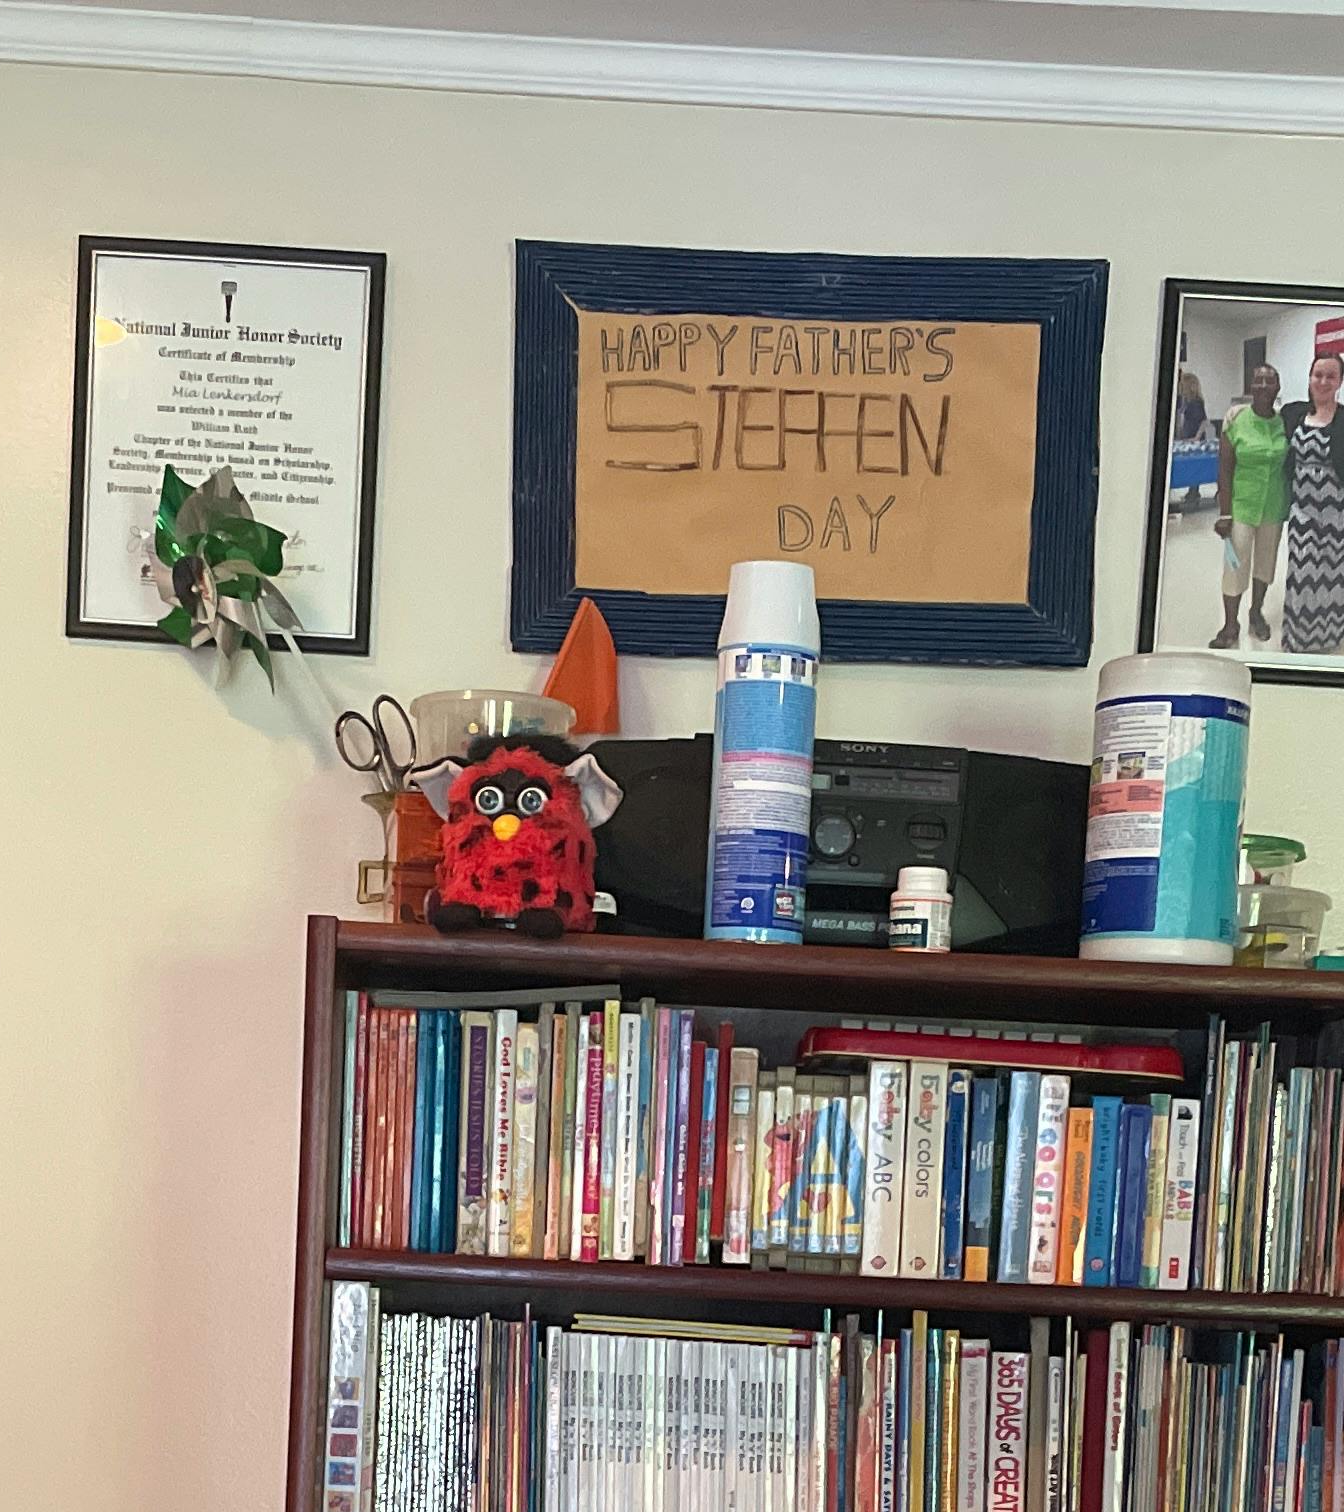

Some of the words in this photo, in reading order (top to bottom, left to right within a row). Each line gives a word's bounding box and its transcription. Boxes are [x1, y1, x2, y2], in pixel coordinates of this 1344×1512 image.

[180, 322, 230, 340] Junior
[237, 326, 285, 343] Honor
[288, 329, 342, 350] Society
[159, 347, 211, 361] Certificate
[216, 352, 226, 361] of
[231, 352, 295, 366] Membership
[601, 323, 738, 376] HAPPY
[751, 327, 955, 382] FATHER'S
[172, 386, 198, 397] Mia
[180, 370, 202, 381] This
[254, 376, 273, 386] that
[192, 421, 229, 432] William
[605, 379, 951, 477] STEFFEN
[155, 450, 212, 463] Membership
[205, 438, 244, 450] National
[248, 442, 279, 452] Junior
[284, 443, 313, 454] Honor
[778, 495, 895, 553] DAY
[840, 744, 889, 753] SONY
[812, 919, 844, 929] MEGA
[847, 920, 875, 931] BASS
[500, 1037, 512, 1067] God
[500, 1072, 511, 1113] Loves
[470, 1098, 483, 1142] JESUS
[499, 1118, 509, 1138] Me
[872, 1153, 892, 1202] ABC
[915, 1139, 935, 1198] colors
[1175, 1180, 1194, 1222] BABY
[996, 1356, 1025, 1389] 365
[996, 1392, 1022, 1441] DAYS
[883, 1444, 893, 1472] DAYS
[999, 1442, 1013, 1454] of
